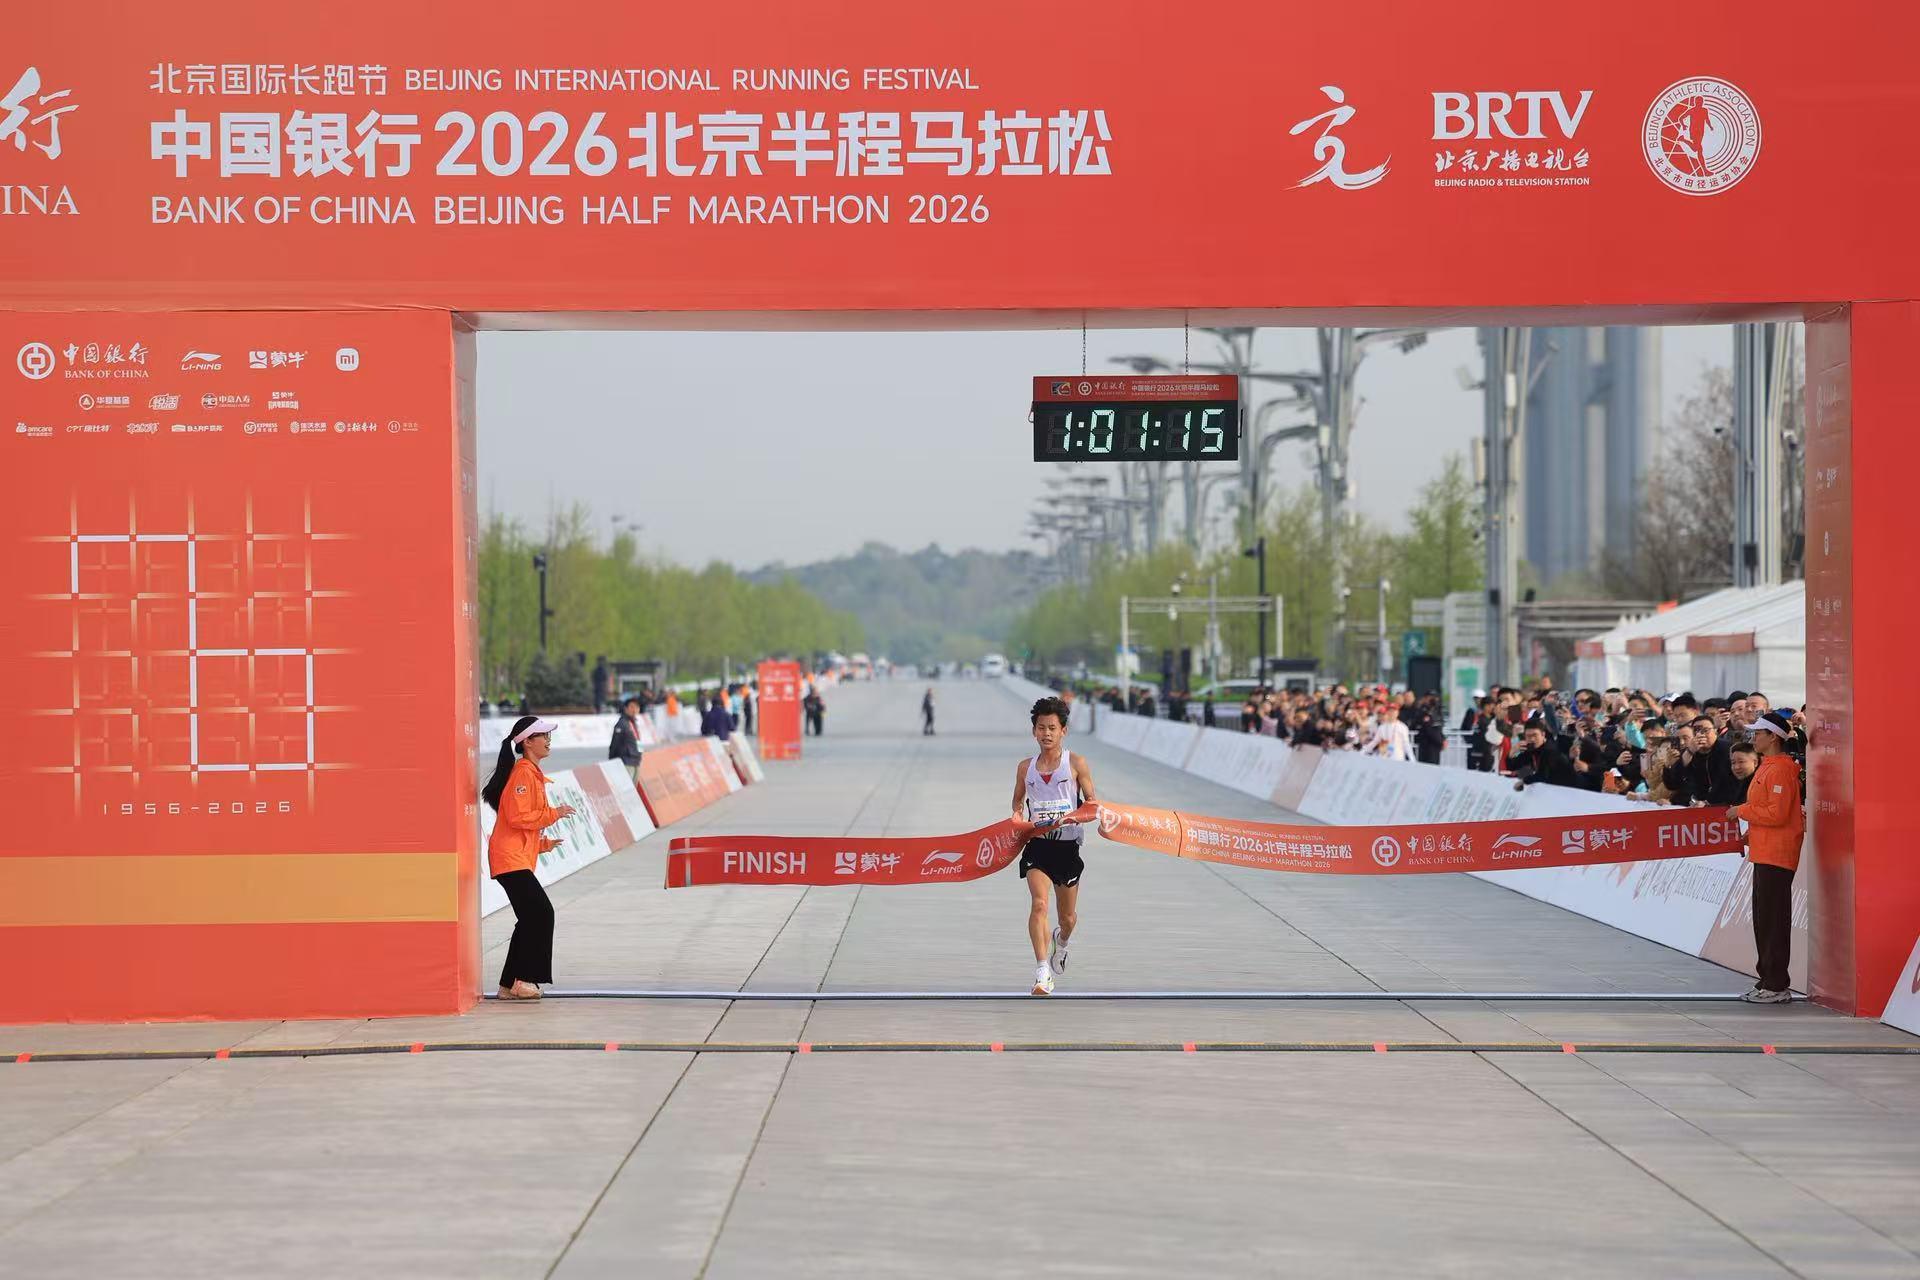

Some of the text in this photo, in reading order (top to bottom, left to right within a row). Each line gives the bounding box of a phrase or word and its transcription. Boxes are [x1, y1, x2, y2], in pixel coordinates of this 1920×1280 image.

[149, 63, 388, 95] 北京国际长跑节
[405, 69, 979, 91] BEIJING INTERNATIONAL RUNNING FESTIVAL
[0, 66, 79, 160] 行
[1432, 90, 1594, 140] BRTV
[1648, 83, 1756, 149] BEIJING ATHLETIC ASSOCIATION
[1434, 149, 1590, 173] 北京广播电视台
[1654, 155, 1750, 189] 北京市田径运动协会
[1434, 178, 1590, 188] BEIJING RADIO & TELEVISION STATION
[151, 195, 990, 224] BANK OF CHINA BEIJING HALF MARATHON 2026
[181, 363, 222, 371] LI-NING
[271, 351, 305, 368] 蒙牛
[65, 370, 149, 379] BANK OF CHINA
[1121, 827, 1141, 839] BANK
[1143, 833, 1152, 841] OF
[1589, 828, 1634, 852] 蒙牛
[1658, 822, 1739, 848] FINISH
[723, 851, 807, 874] FINISH
[860, 852, 900, 874] 蒙牛
[1186, 845, 1201, 854] BANK
[1211, 849, 1230, 858] CHINA
[1232, 853, 1255, 861] BEIJING
[1257, 855, 1273, 864] HALF
[1275, 858, 1312, 867] MARATHON
[1408, 857, 1432, 865] BANK
[1447, 856, 1475, 864] CHINA
[1492, 848, 1543, 860] LI-NING
[921, 866, 963, 875] LI-NING
